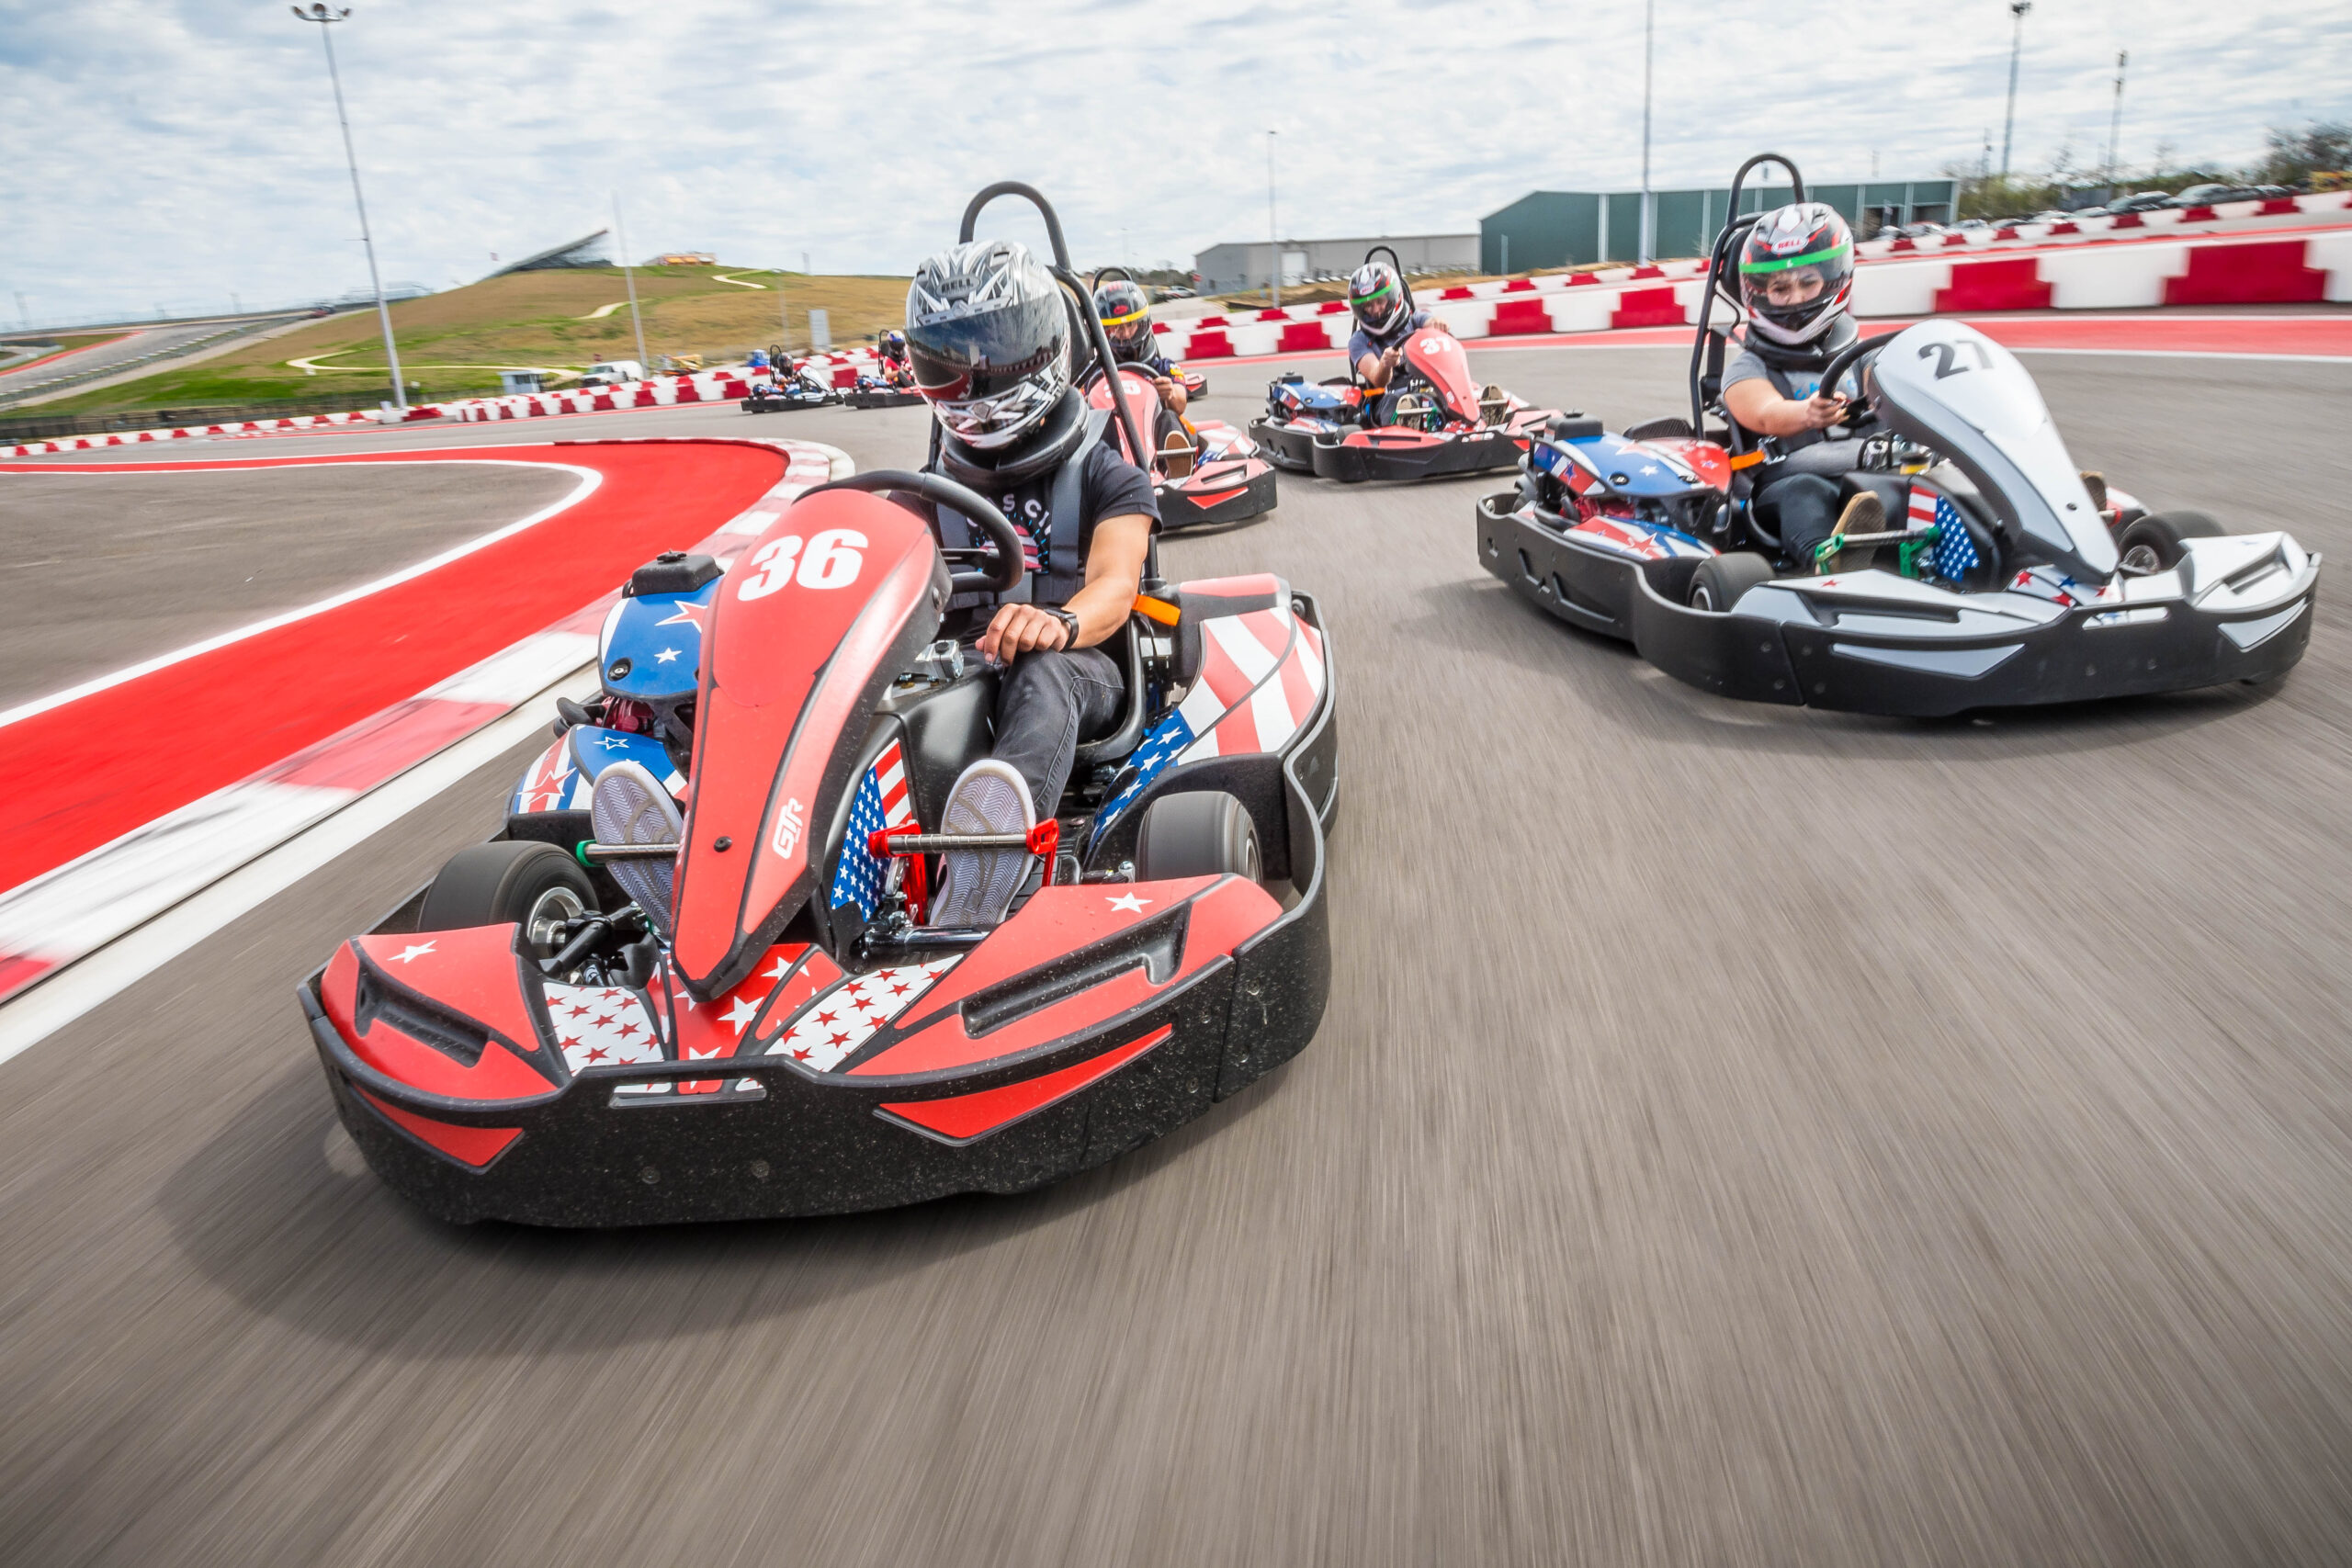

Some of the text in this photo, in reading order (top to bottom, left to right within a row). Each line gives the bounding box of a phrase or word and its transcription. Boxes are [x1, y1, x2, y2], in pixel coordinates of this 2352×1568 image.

[1777, 238, 1801, 249] BELL
[942, 277, 974, 294] BELL
[1917, 339, 1994, 379] 27
[738, 528, 868, 602] 36
[773, 797, 803, 859] GTR
